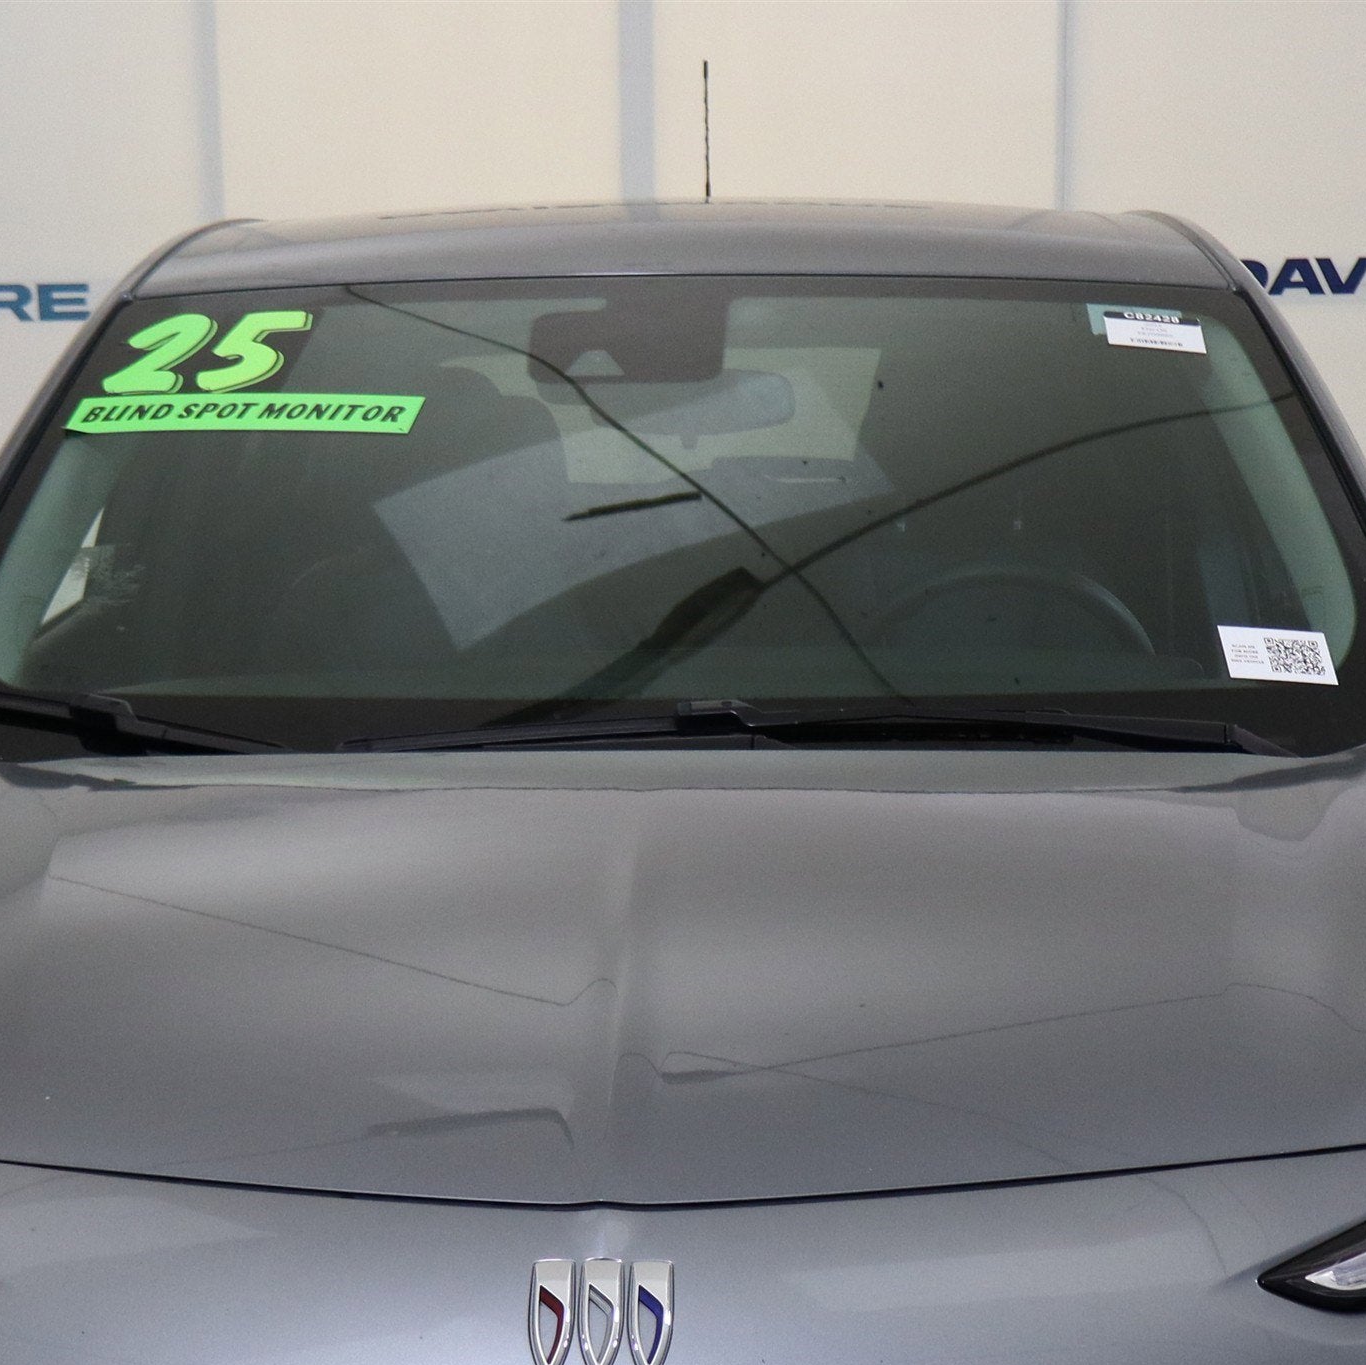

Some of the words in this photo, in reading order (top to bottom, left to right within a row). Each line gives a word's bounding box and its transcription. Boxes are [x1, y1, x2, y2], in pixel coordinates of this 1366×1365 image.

[101, 310, 314, 395] 25
[82, 405, 173, 424] BLIND
[177, 402, 253, 420] SPOT
[257, 402, 407, 424] MONITOR
